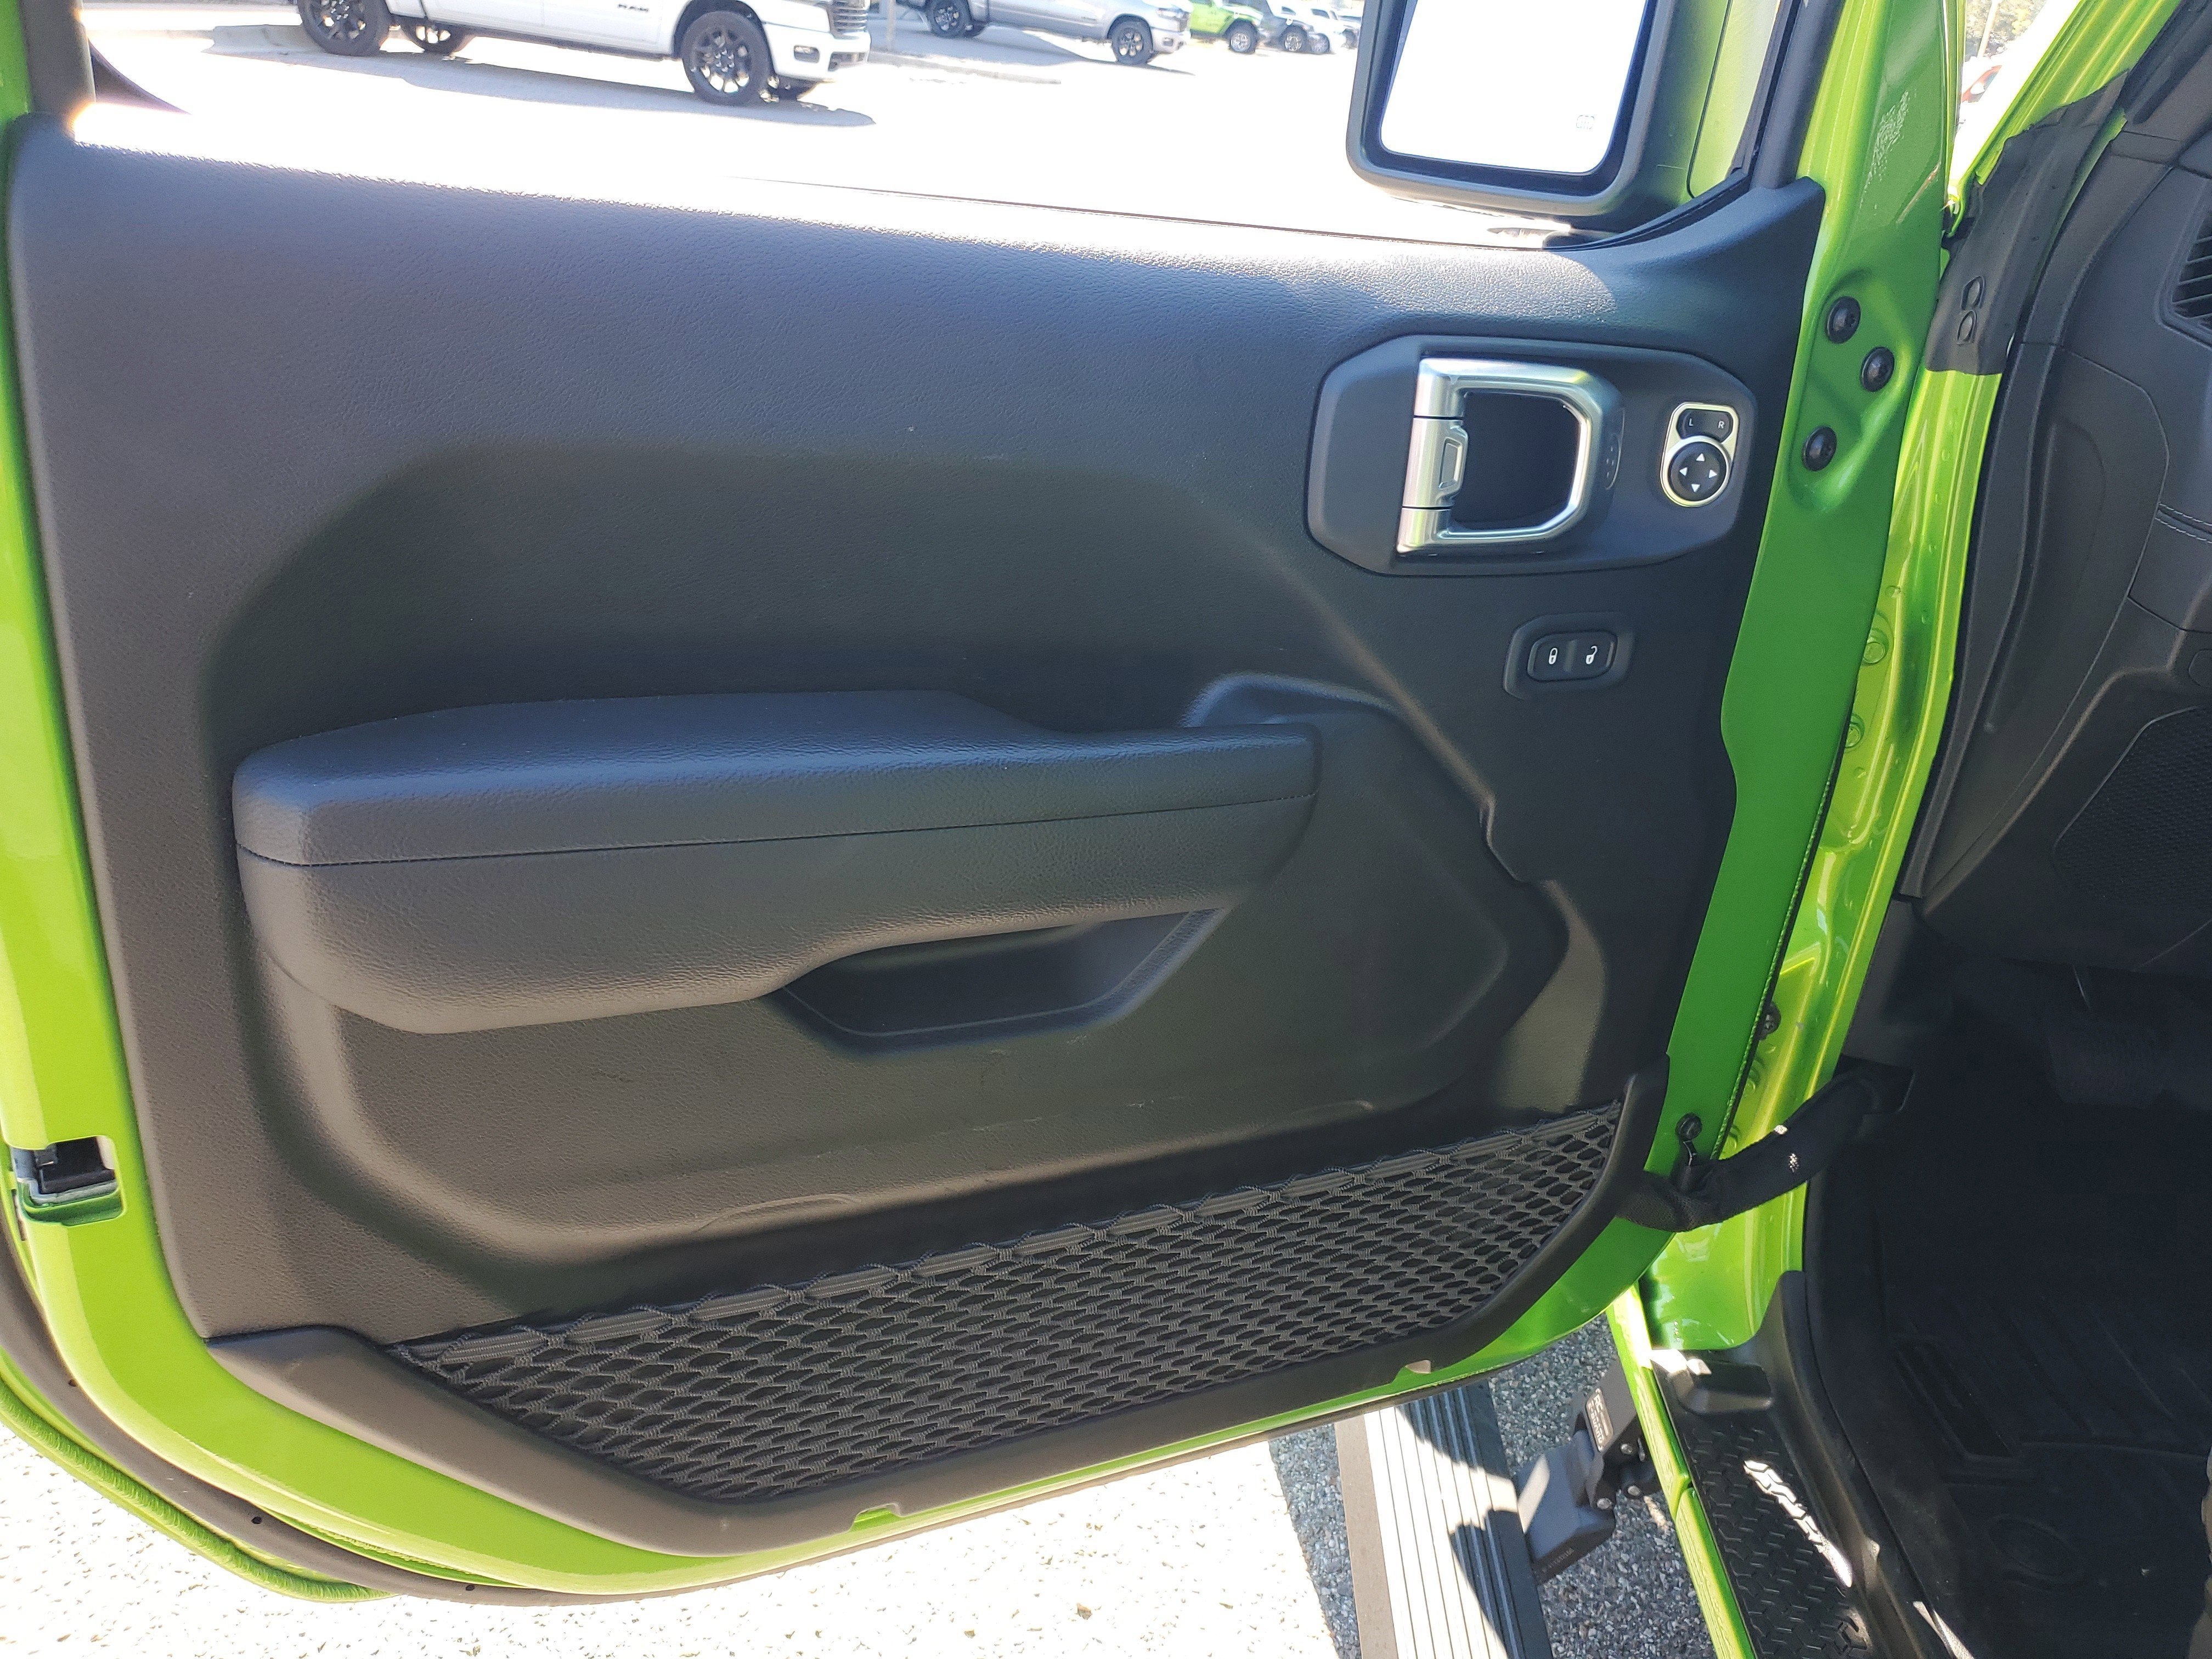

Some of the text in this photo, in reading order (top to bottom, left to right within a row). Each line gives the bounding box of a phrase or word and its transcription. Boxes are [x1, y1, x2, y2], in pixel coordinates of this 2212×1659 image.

[618, 4, 649, 12] RAM
[1689, 418, 1725, 429] L R
